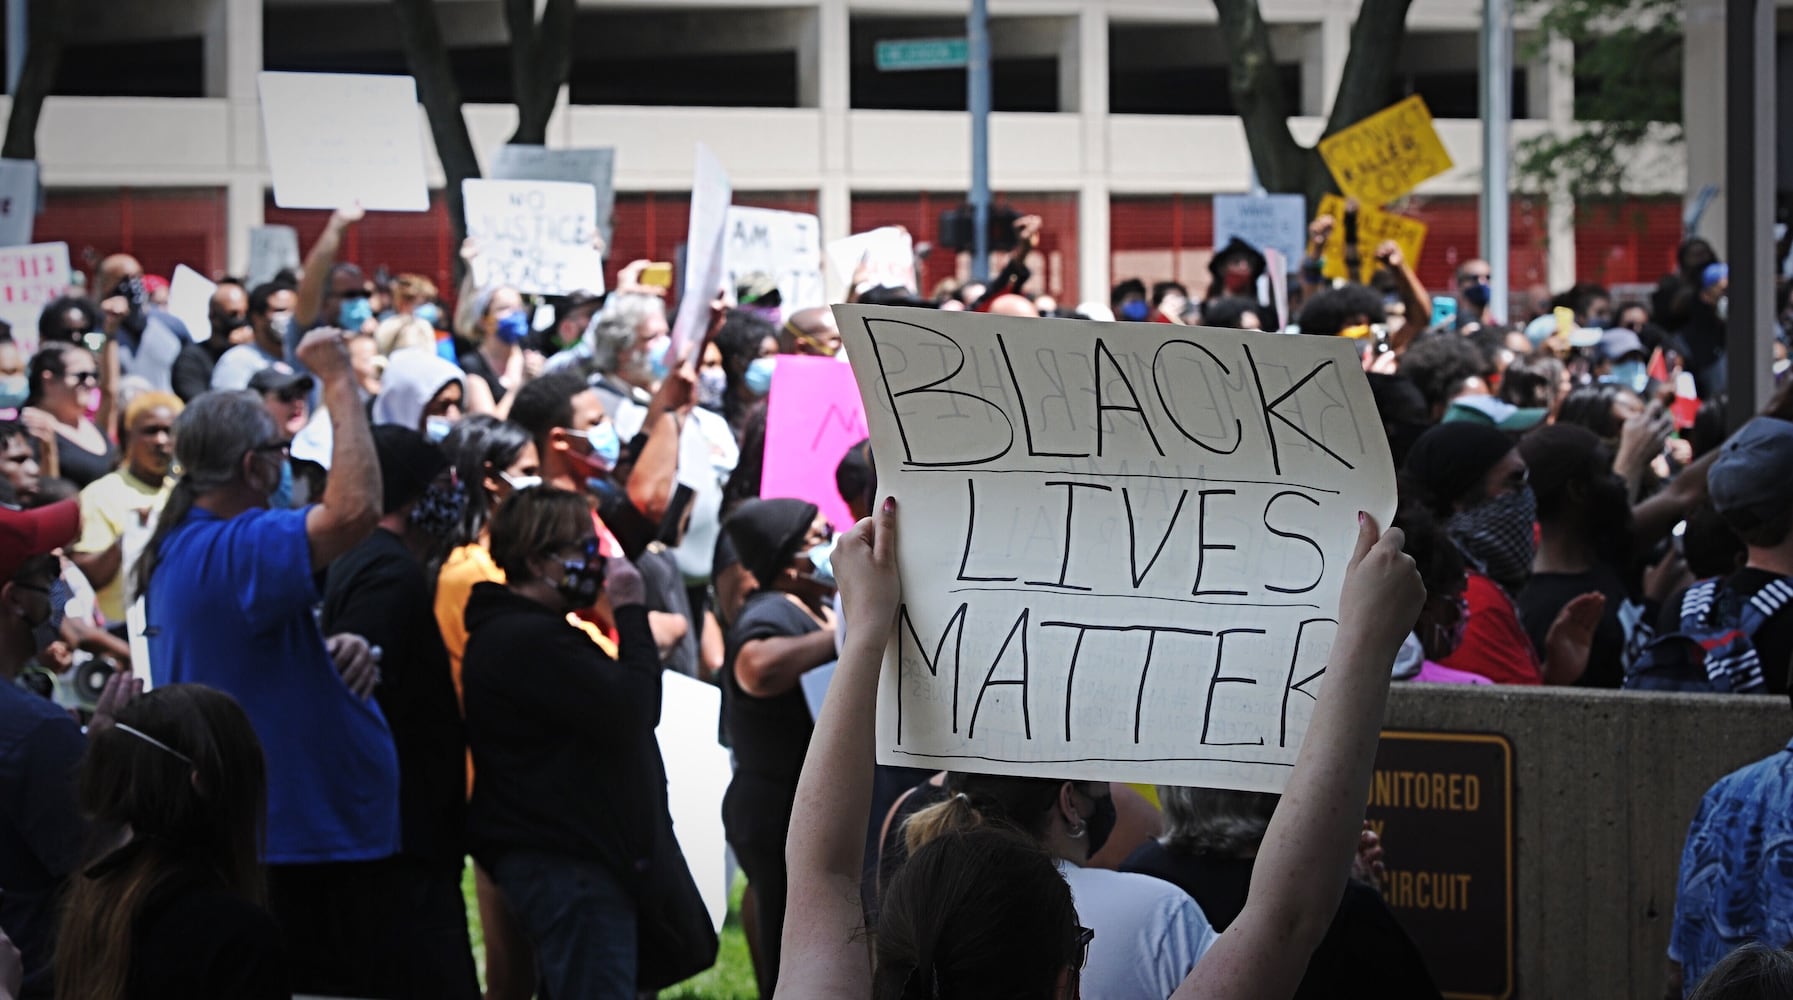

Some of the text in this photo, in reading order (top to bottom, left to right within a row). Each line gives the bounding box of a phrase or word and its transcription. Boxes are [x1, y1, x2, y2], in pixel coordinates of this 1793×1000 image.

[509, 190, 544, 210] NO
[1357, 155, 1436, 201] COPS
[480, 215, 588, 244] JUSTICE
[733, 221, 770, 247] AM
[862, 316, 1355, 475] BLACK
[956, 479, 1325, 595] LIVES
[897, 602, 1339, 748] MATTER
[1367, 769, 1481, 812] NITORED
